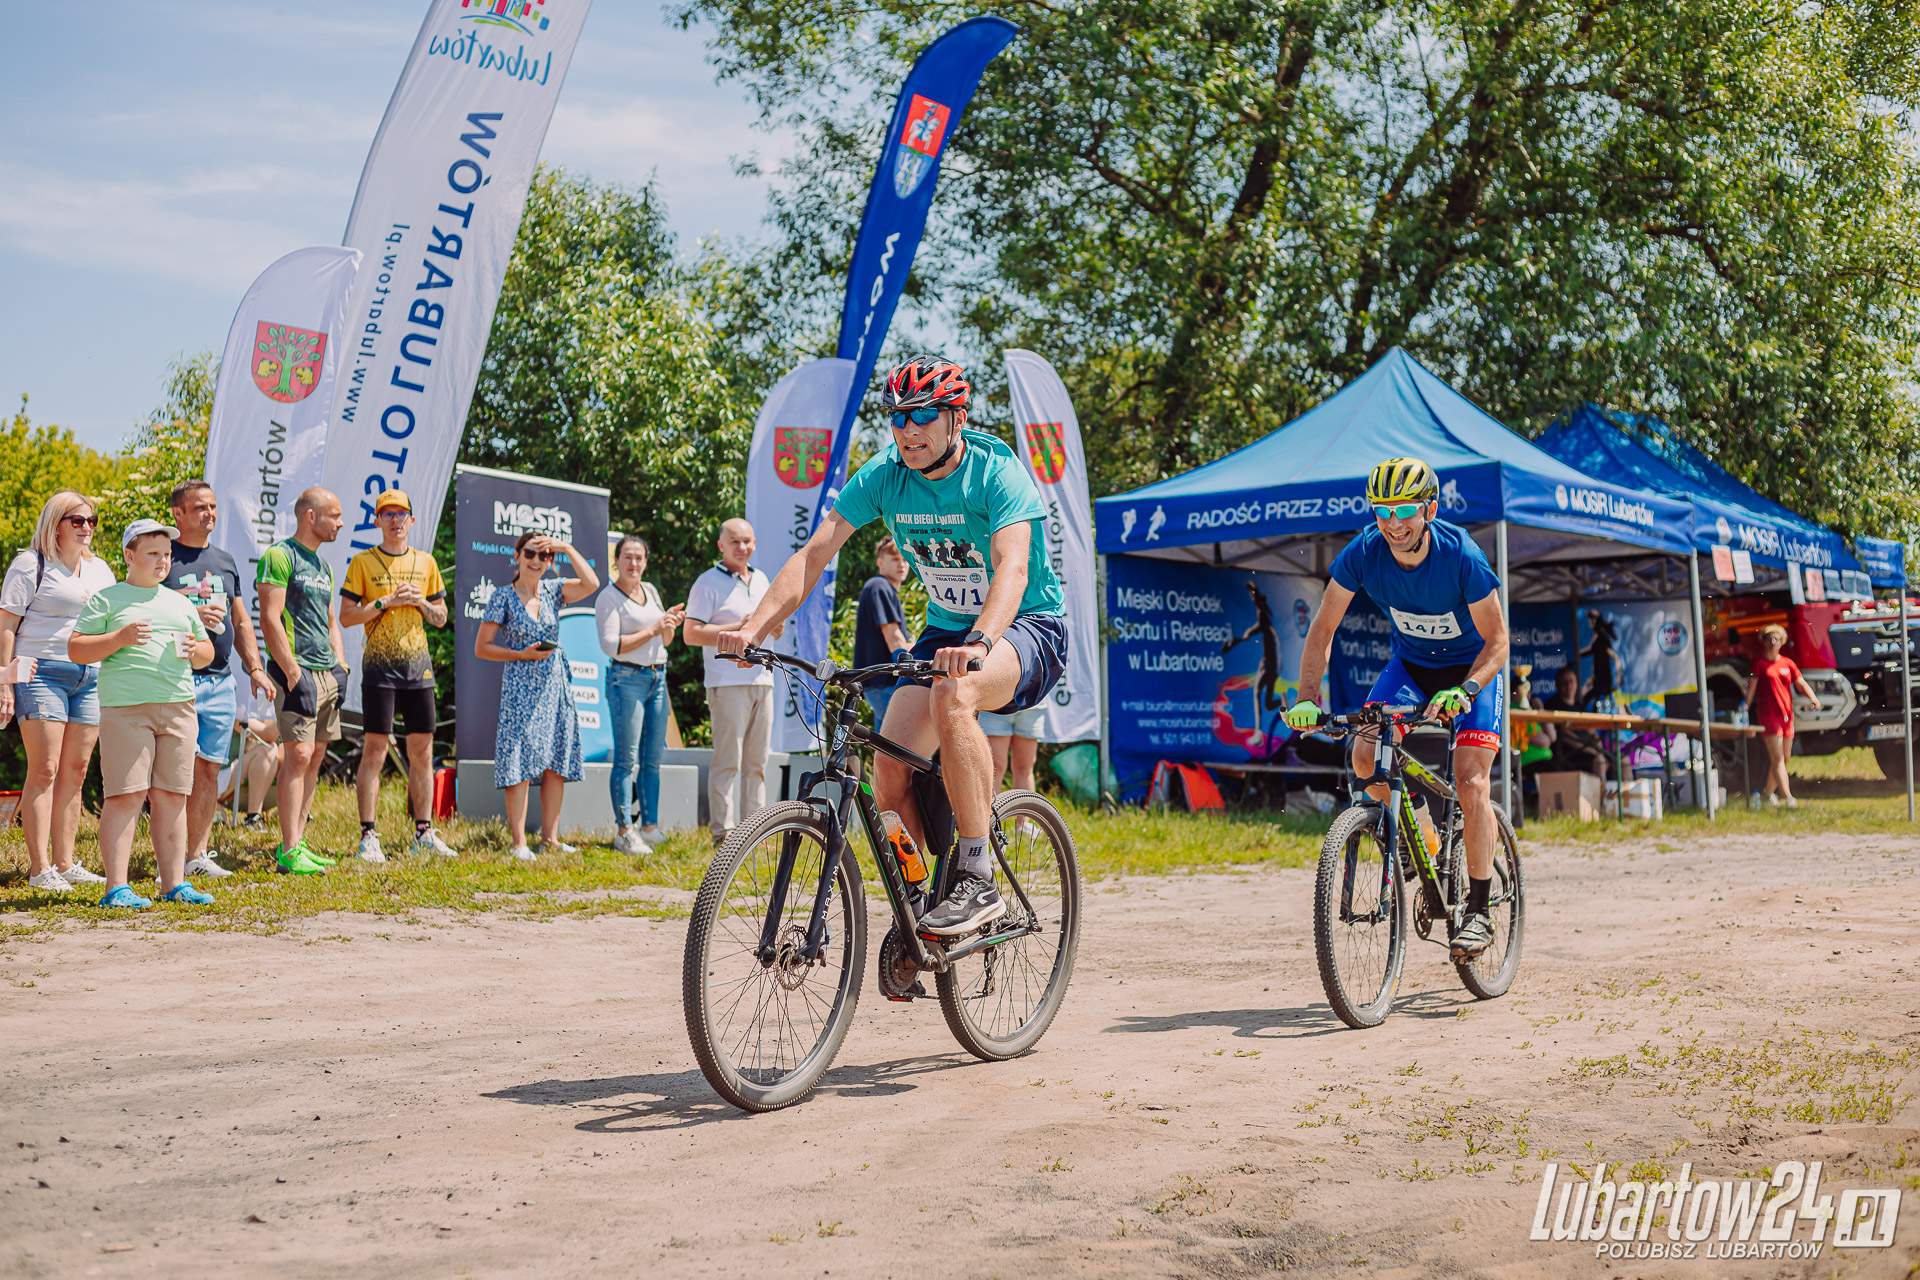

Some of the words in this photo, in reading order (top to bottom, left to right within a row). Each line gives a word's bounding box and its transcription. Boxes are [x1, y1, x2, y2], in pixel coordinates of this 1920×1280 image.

[913, 514, 934, 525] BIEGI
[1186, 502, 1262, 530] RADOŚĆ
[1264, 498, 1323, 520] PRZEZ
[1326, 495, 1371, 517] SPO
[1608, 494, 1655, 527] Lubartów
[931, 584, 984, 606] 14/1
[1116, 586, 1164, 614] Miejski
[1166, 590, 1224, 613] Ośrodek
[1113, 617, 1161, 643] Sportu
[1162, 620, 1168, 641] i
[572, 666, 595, 674] PORT
[1128, 654, 1142, 670] w
[1144, 650, 1225, 672] Lubartowie
[869, 802, 906, 901] MAXIM
[821, 865, 840, 920] MAXIM
